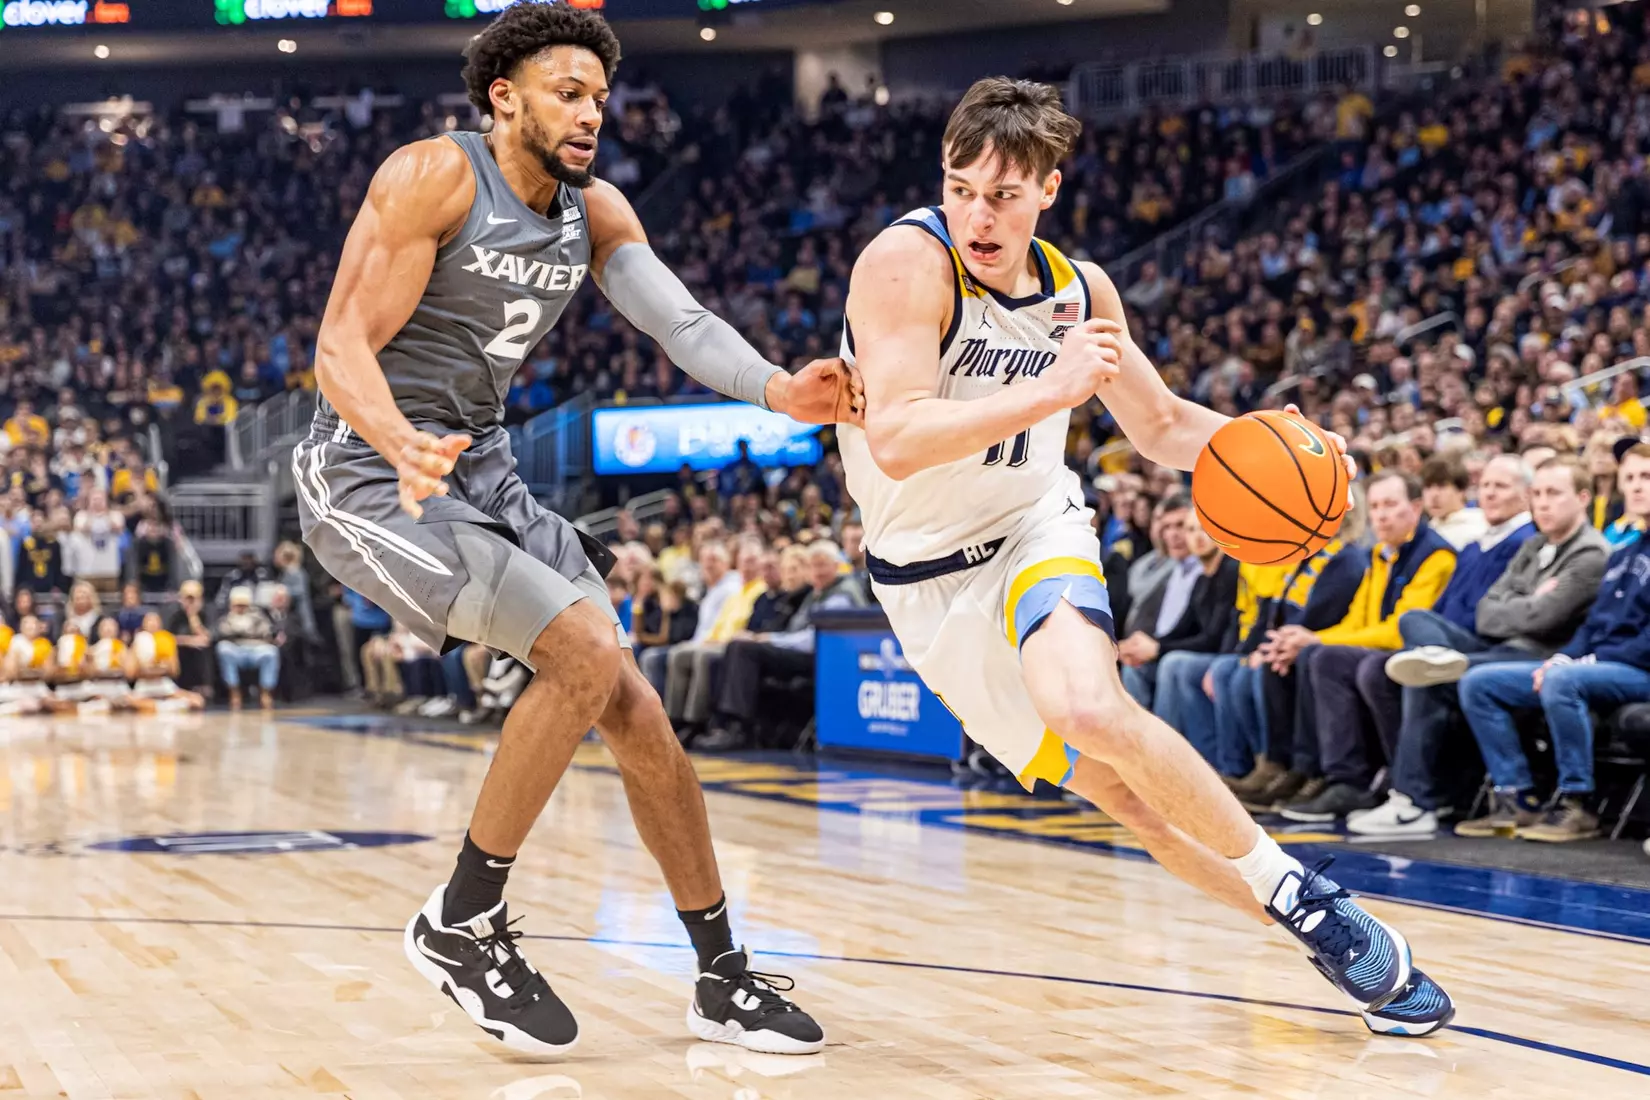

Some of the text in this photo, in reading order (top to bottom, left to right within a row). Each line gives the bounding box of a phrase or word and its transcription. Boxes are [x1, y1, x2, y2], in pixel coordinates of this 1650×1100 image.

[3, 0, 88, 26] clover
[462, 244, 588, 291] XAVIER
[484, 298, 542, 360] 2
[949, 338, 1057, 386] Marque
